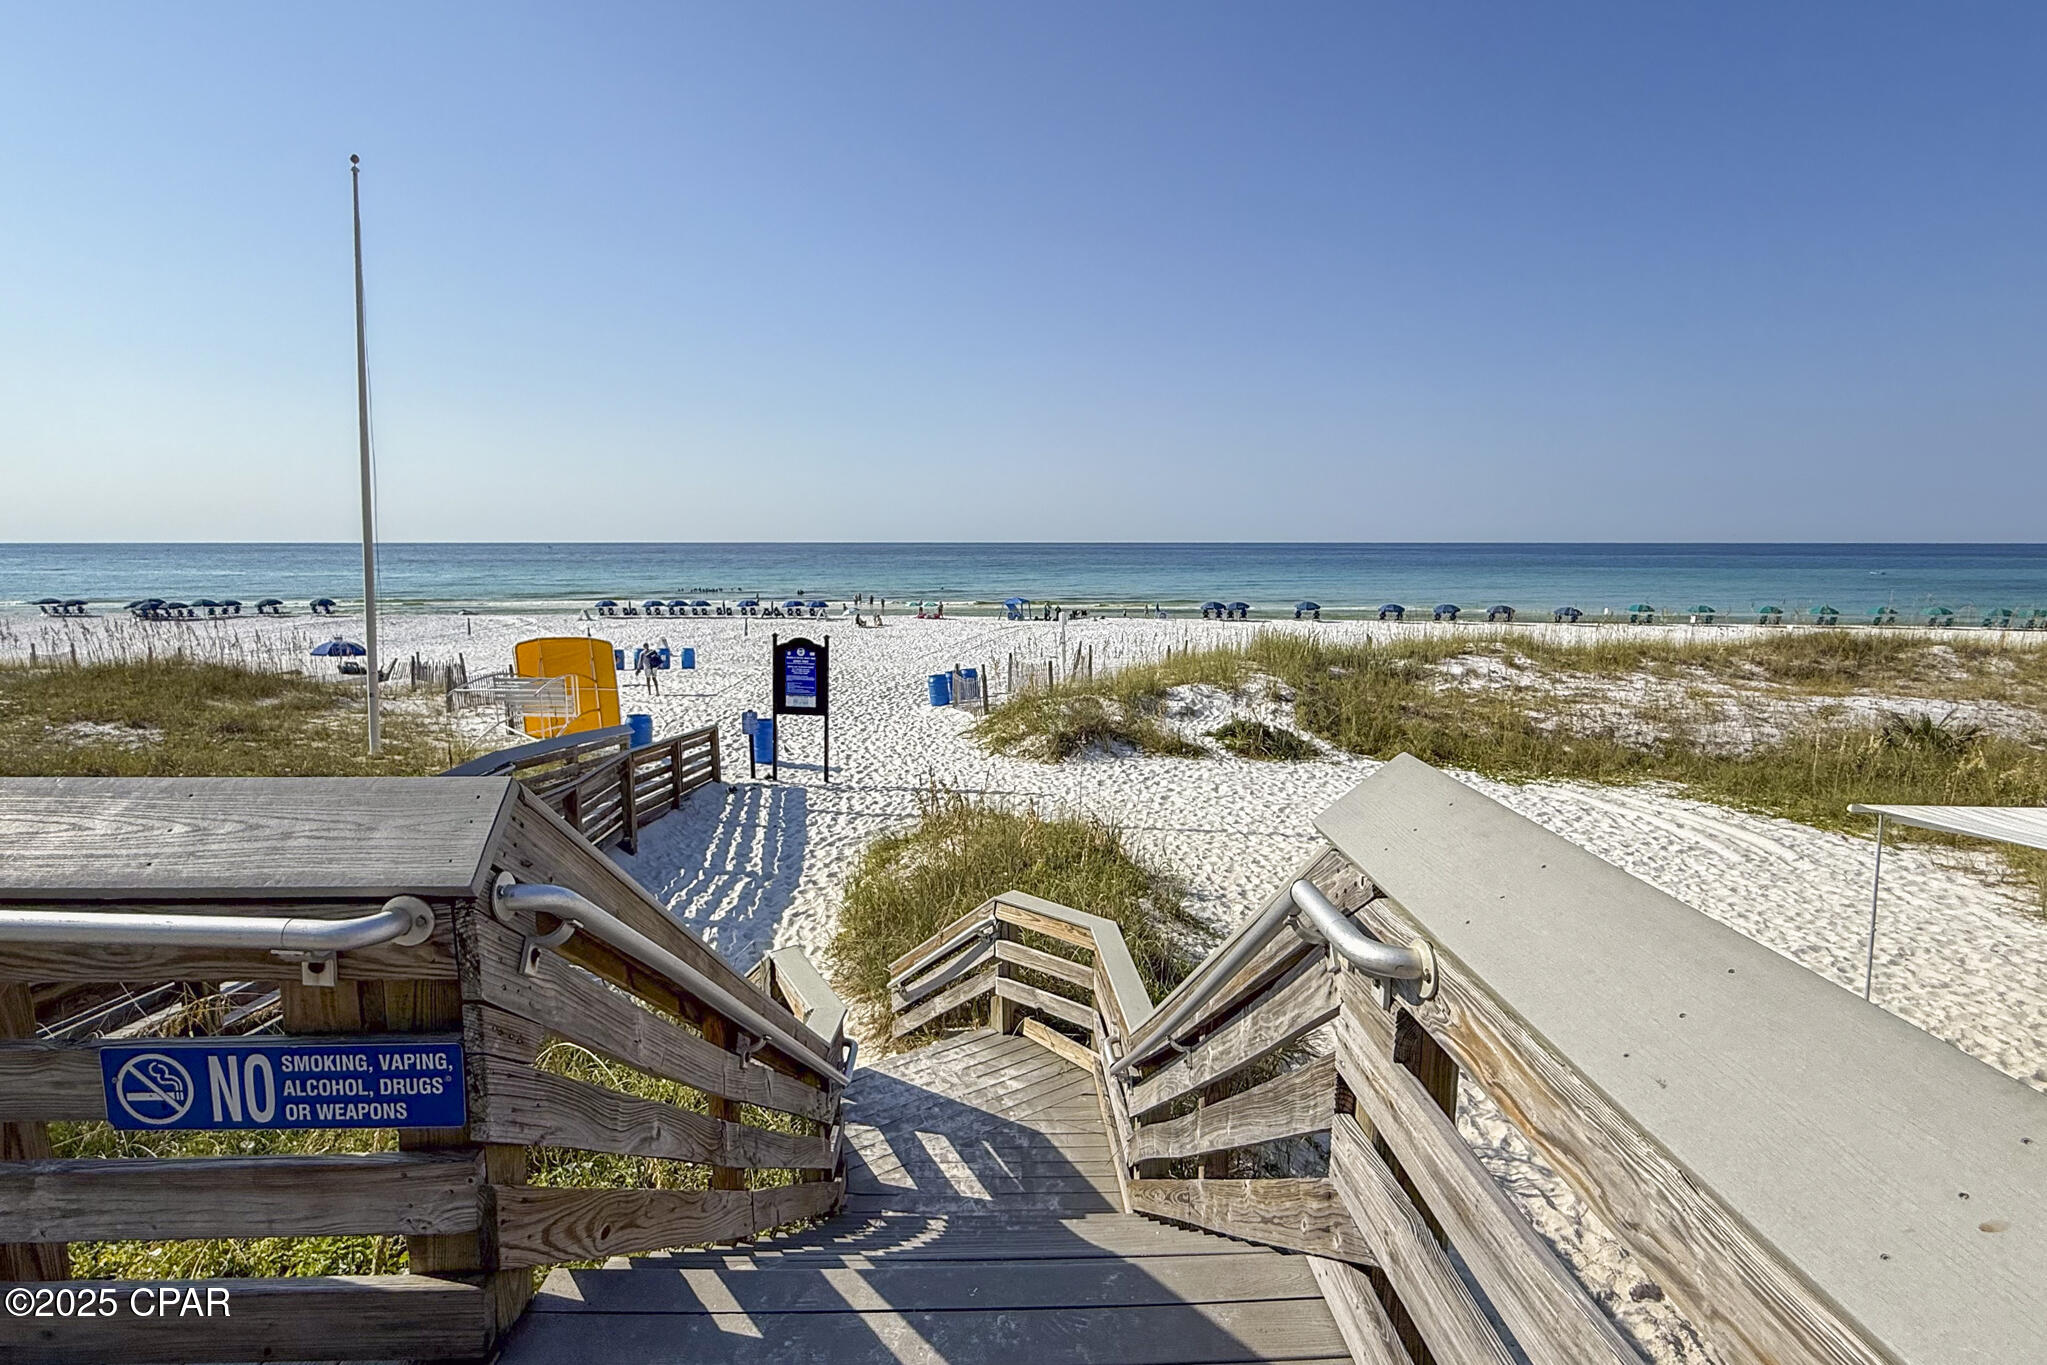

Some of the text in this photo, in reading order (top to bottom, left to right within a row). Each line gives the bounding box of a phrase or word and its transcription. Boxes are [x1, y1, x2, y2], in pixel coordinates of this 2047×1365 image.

[281, 1053, 453, 1074] SMOKING, VAPING,
[208, 1053, 276, 1123] NO
[283, 1076, 444, 1099] ALCOHOL, DRUGS
[285, 1102, 408, 1121] OR WEAPONS
